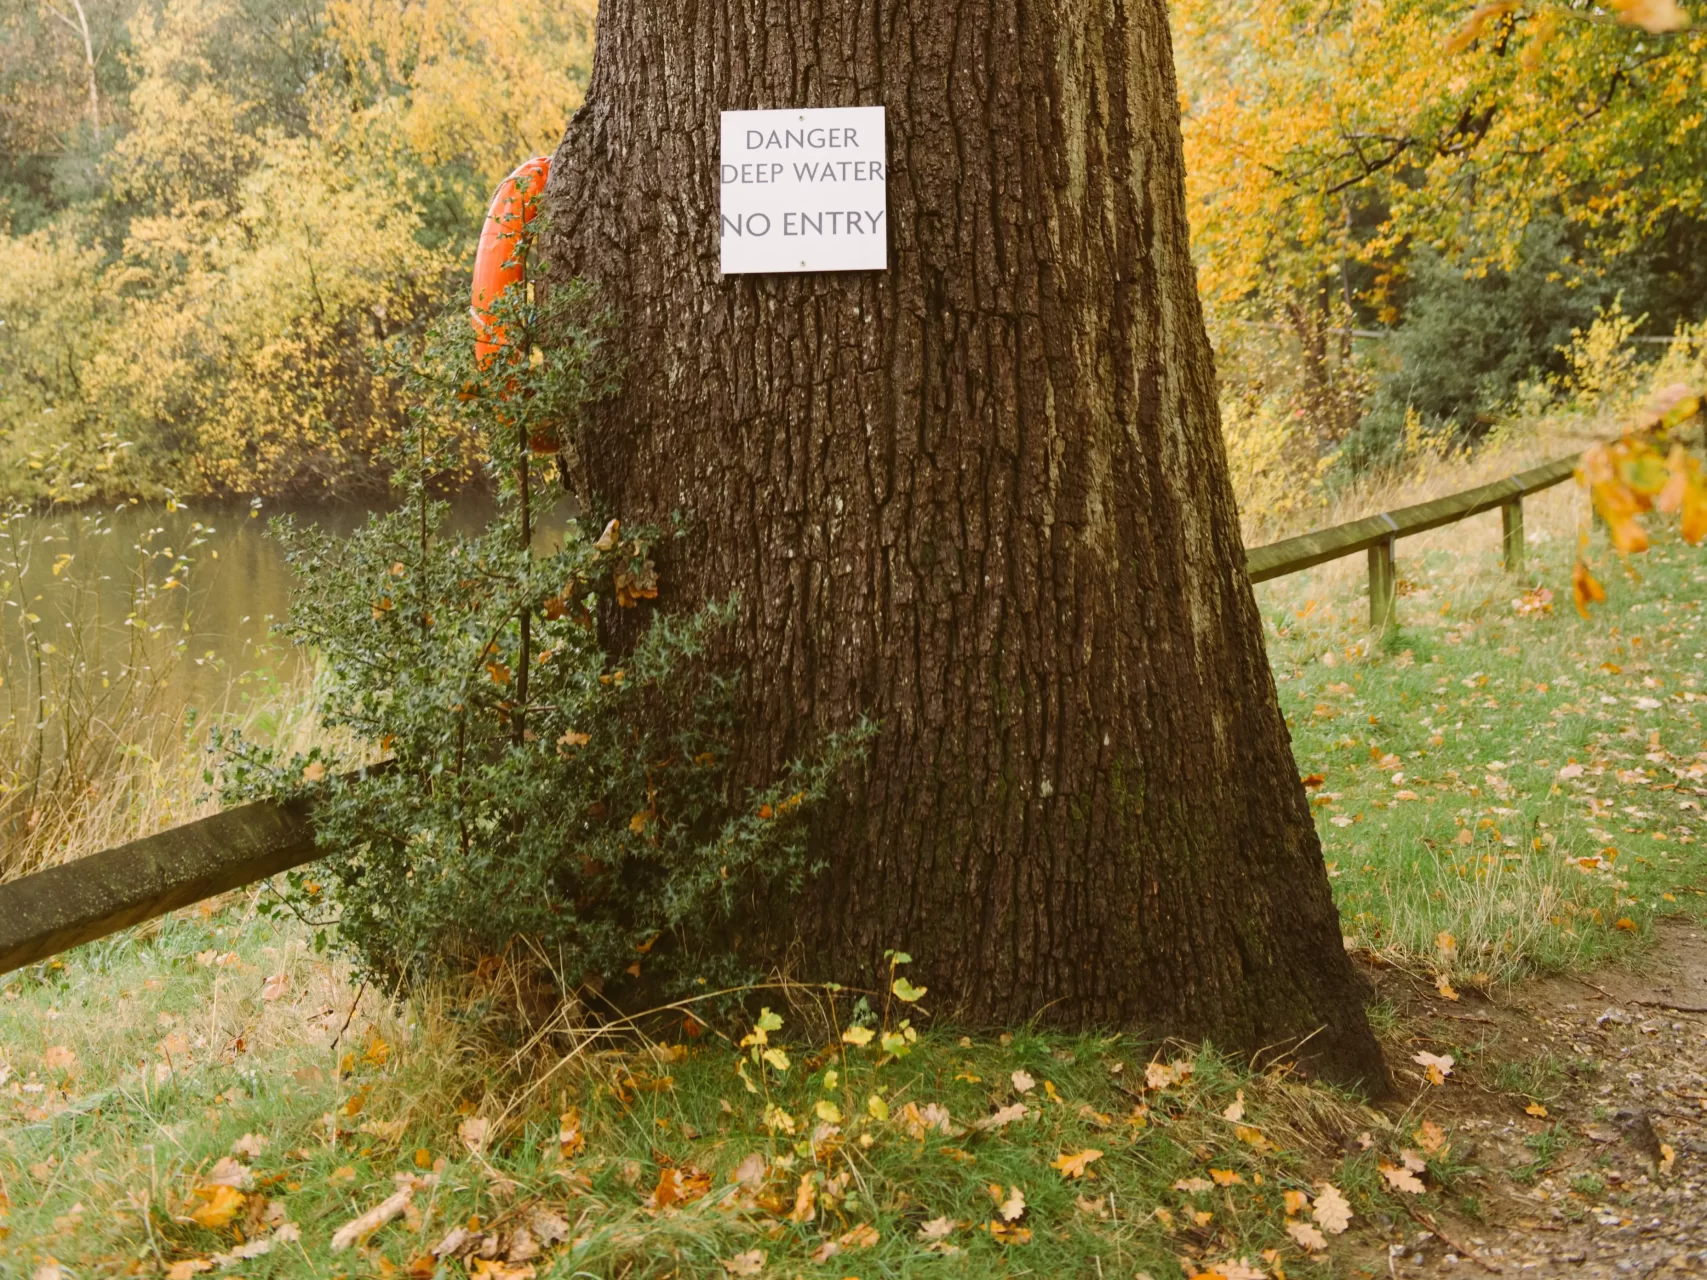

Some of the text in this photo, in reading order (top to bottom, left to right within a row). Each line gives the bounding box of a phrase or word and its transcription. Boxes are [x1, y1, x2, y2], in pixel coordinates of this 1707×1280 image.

[746, 128, 860, 149] DANGER
[721, 161, 884, 184] DEEP WATER
[721, 210, 884, 237] NO ENTRY
